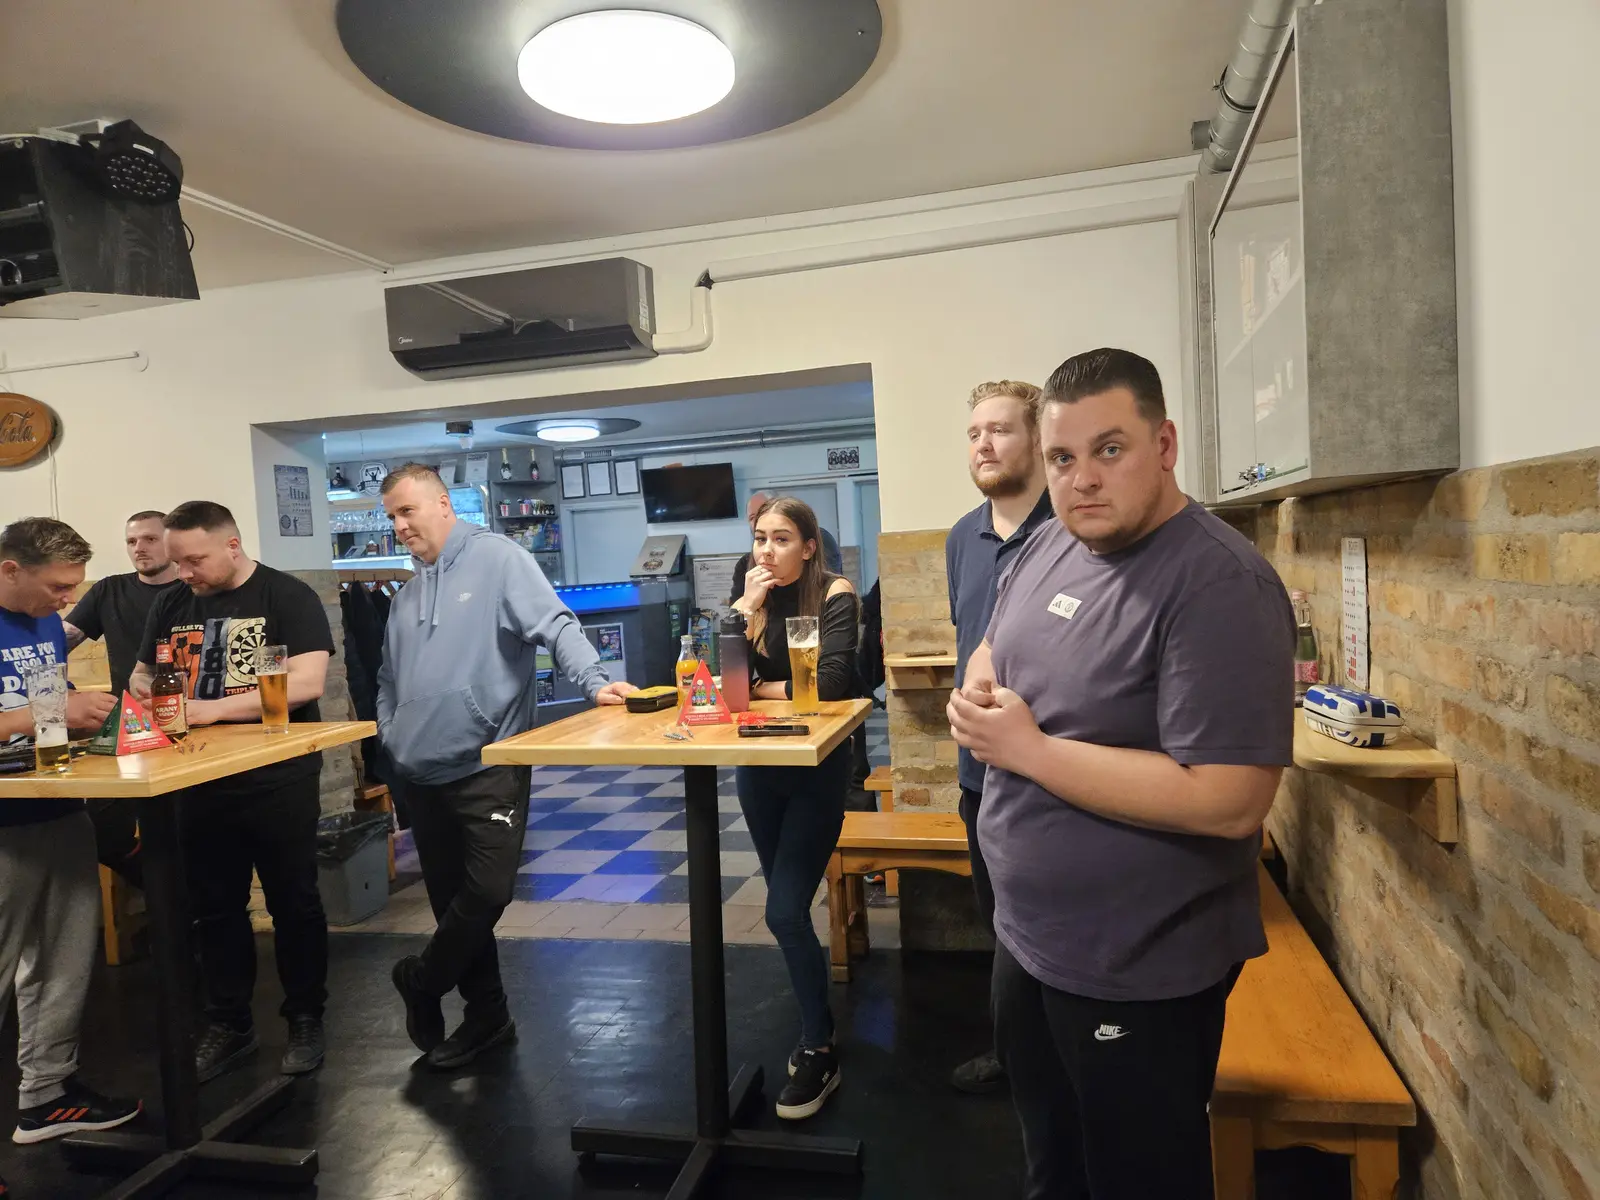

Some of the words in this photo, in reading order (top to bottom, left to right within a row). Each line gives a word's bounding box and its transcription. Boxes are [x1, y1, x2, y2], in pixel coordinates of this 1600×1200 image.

[1, 645, 36, 661] ARE
[155, 705, 178, 713] ARANY
[1099, 1024, 1122, 1036] NIKE
